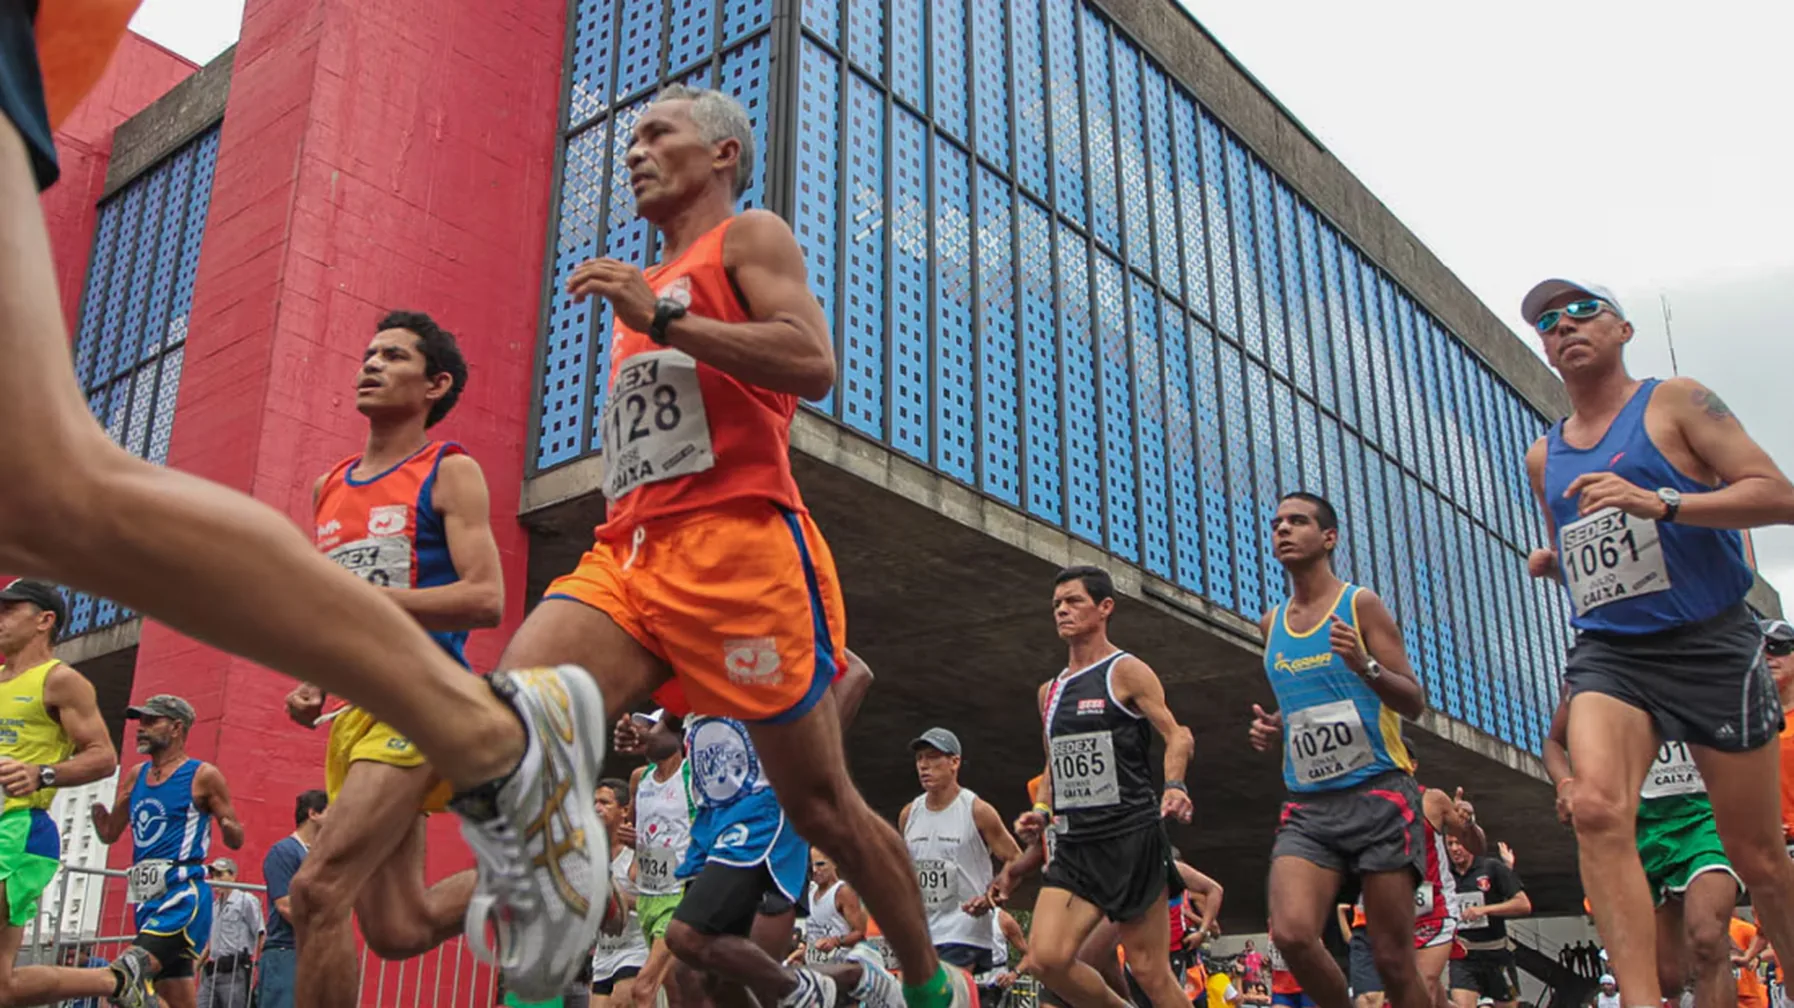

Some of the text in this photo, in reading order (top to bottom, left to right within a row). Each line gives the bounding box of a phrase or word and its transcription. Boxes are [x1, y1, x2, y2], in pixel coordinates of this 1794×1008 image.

[1564, 512, 1626, 551] SEDEX
[1567, 529, 1639, 582] 1061
[1583, 583, 1626, 606] CAIXA
[1293, 722, 1353, 759] 1020
[1054, 752, 1105, 779] 1065
[1308, 762, 1344, 779] CAIXA
[1655, 773, 1695, 786] CAIXA
